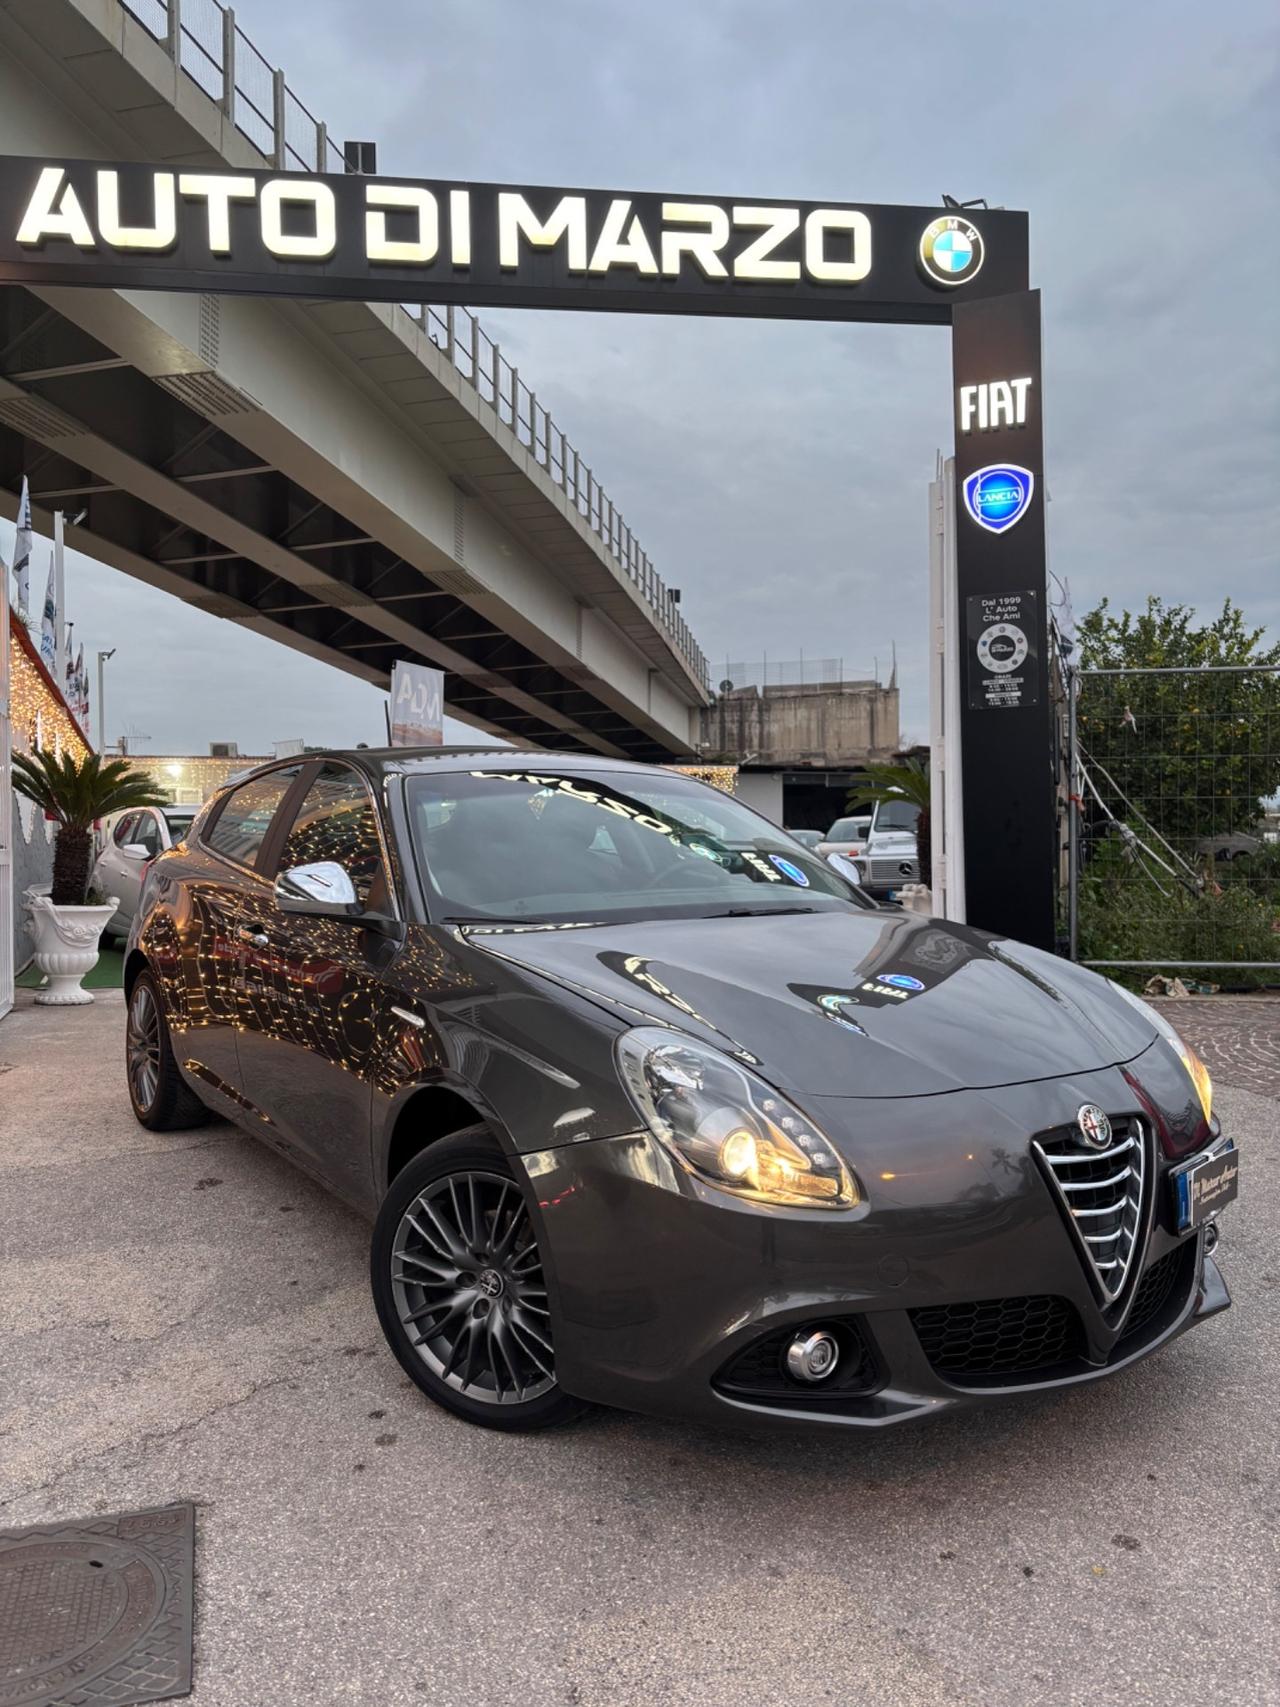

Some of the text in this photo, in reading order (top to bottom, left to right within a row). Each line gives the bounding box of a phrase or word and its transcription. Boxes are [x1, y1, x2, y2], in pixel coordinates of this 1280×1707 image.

[15, 167, 873, 281] AUTO DI MARZO
[960, 377, 1032, 431] FIAT
[978, 491, 1018, 502] LANCIA
[981, 597, 1021, 607] Dal 1999
[982, 614, 1001, 622] Che
